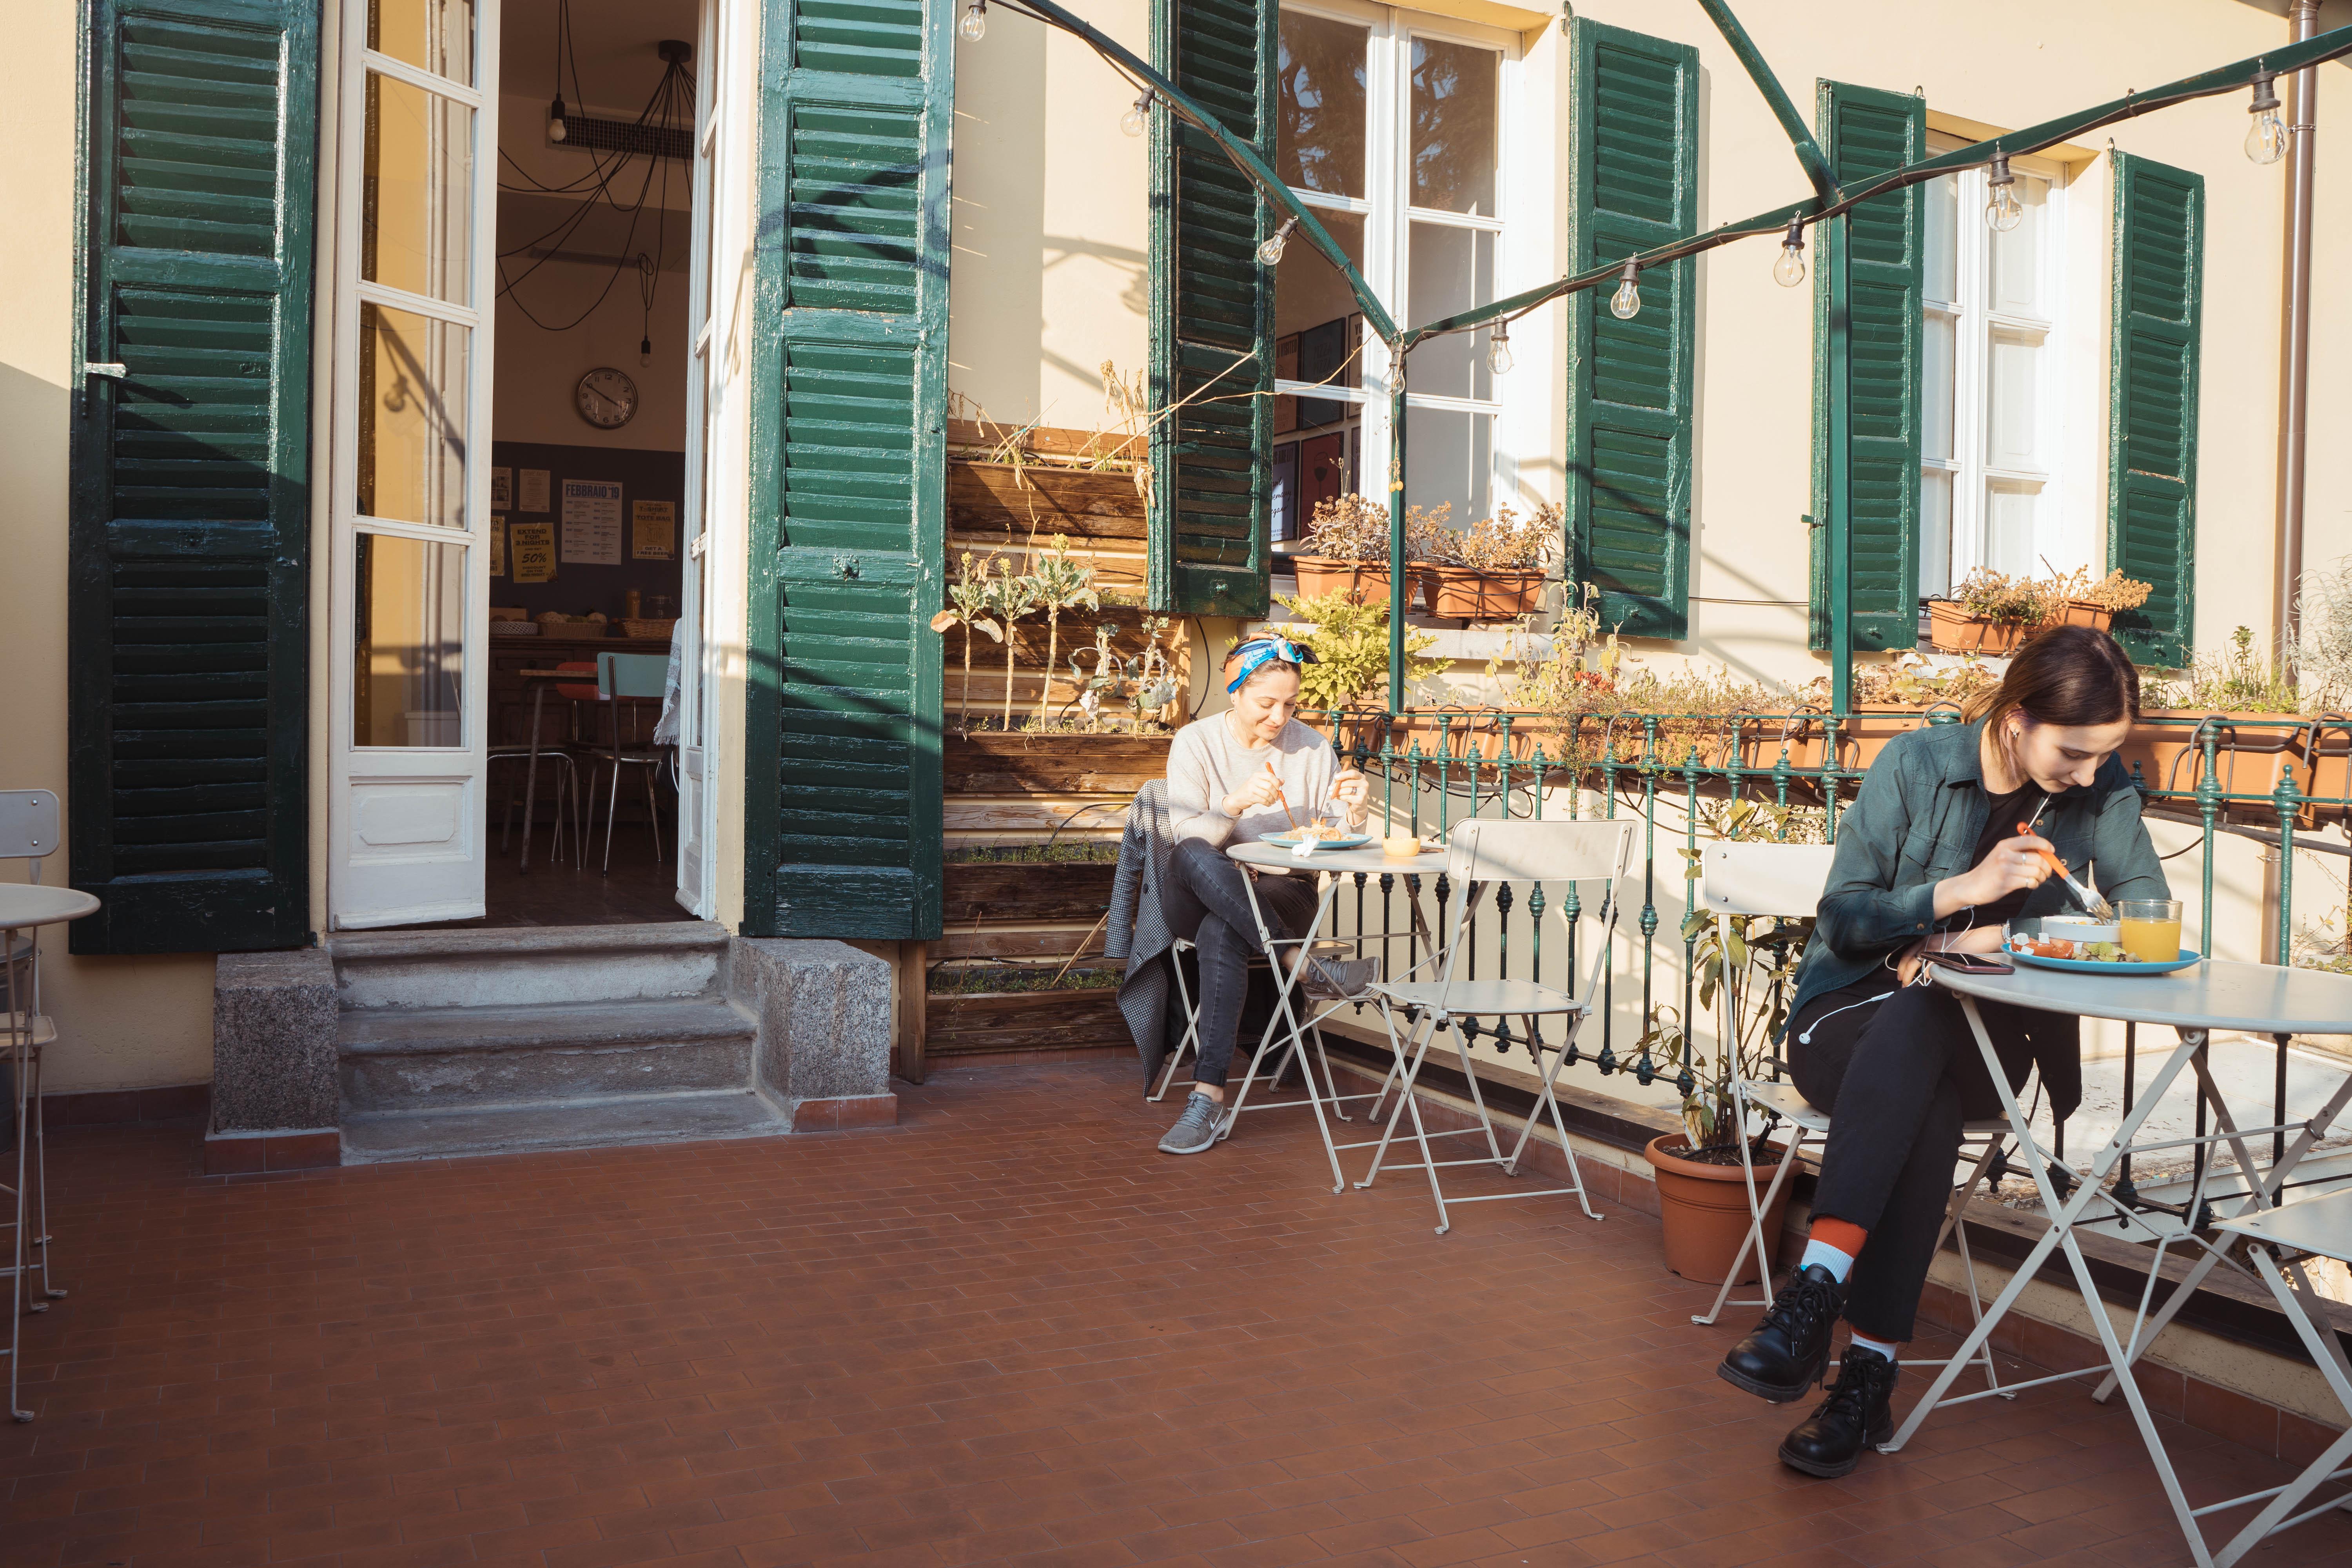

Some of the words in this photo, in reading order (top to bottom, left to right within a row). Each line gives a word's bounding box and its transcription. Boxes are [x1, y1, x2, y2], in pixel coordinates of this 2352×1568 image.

[1281, 339, 1298, 357] VISITED
[1278, 449, 1286, 465] ARE
[566, 484, 607, 497] FEBBRAIO
[1272, 490, 1292, 502] emary
[521, 552, 547, 563] 50%
